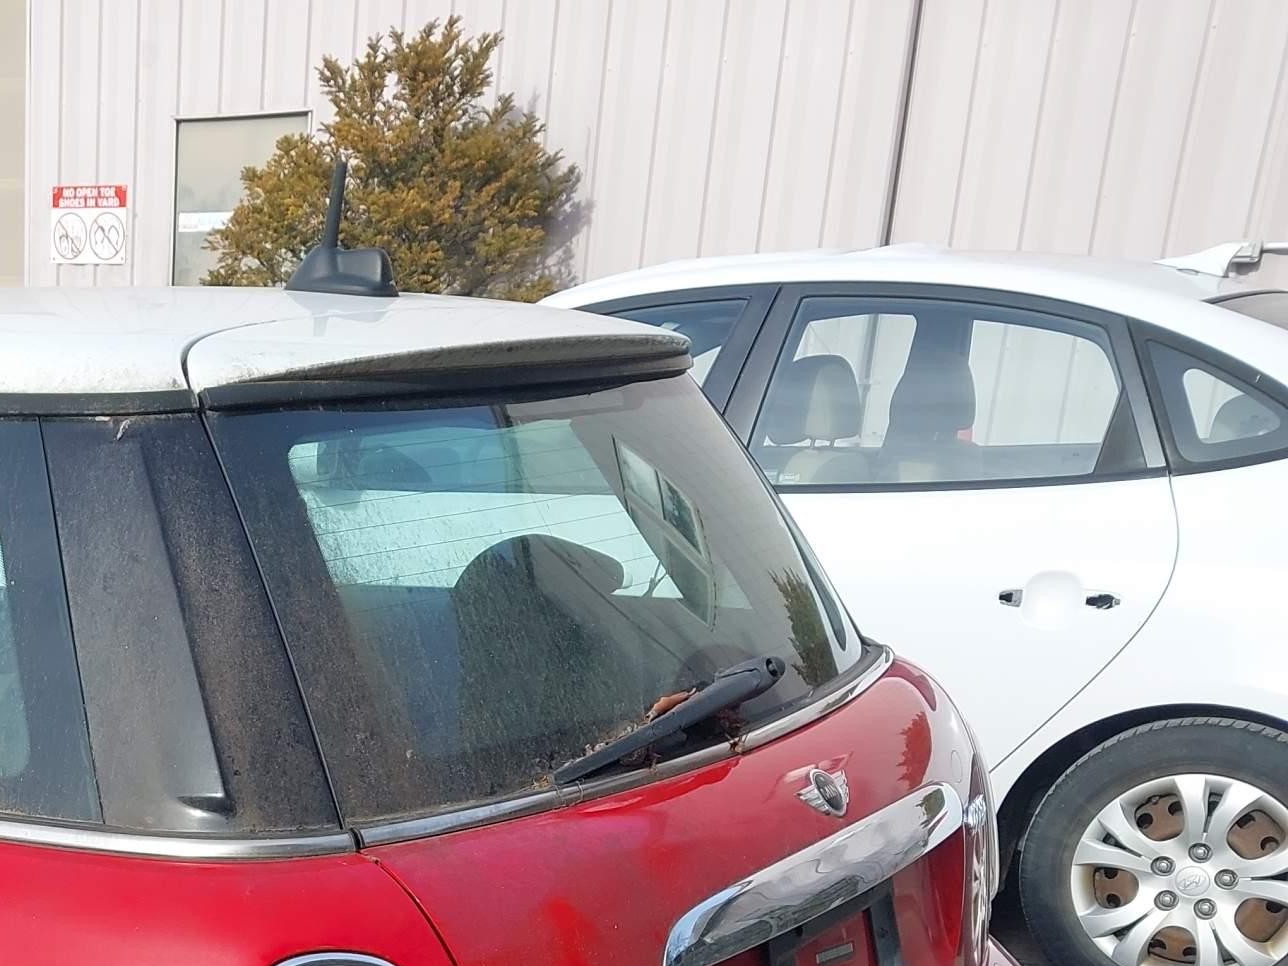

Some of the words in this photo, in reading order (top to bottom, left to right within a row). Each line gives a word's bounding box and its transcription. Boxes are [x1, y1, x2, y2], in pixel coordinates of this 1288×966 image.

[62, 187, 75, 197] NO
[76, 187, 98, 197] OPEN
[99, 186, 116, 197] TOE
[59, 198, 85, 208] SHOES
[87, 198, 96, 207] IN
[97, 197, 120, 207] YARD
